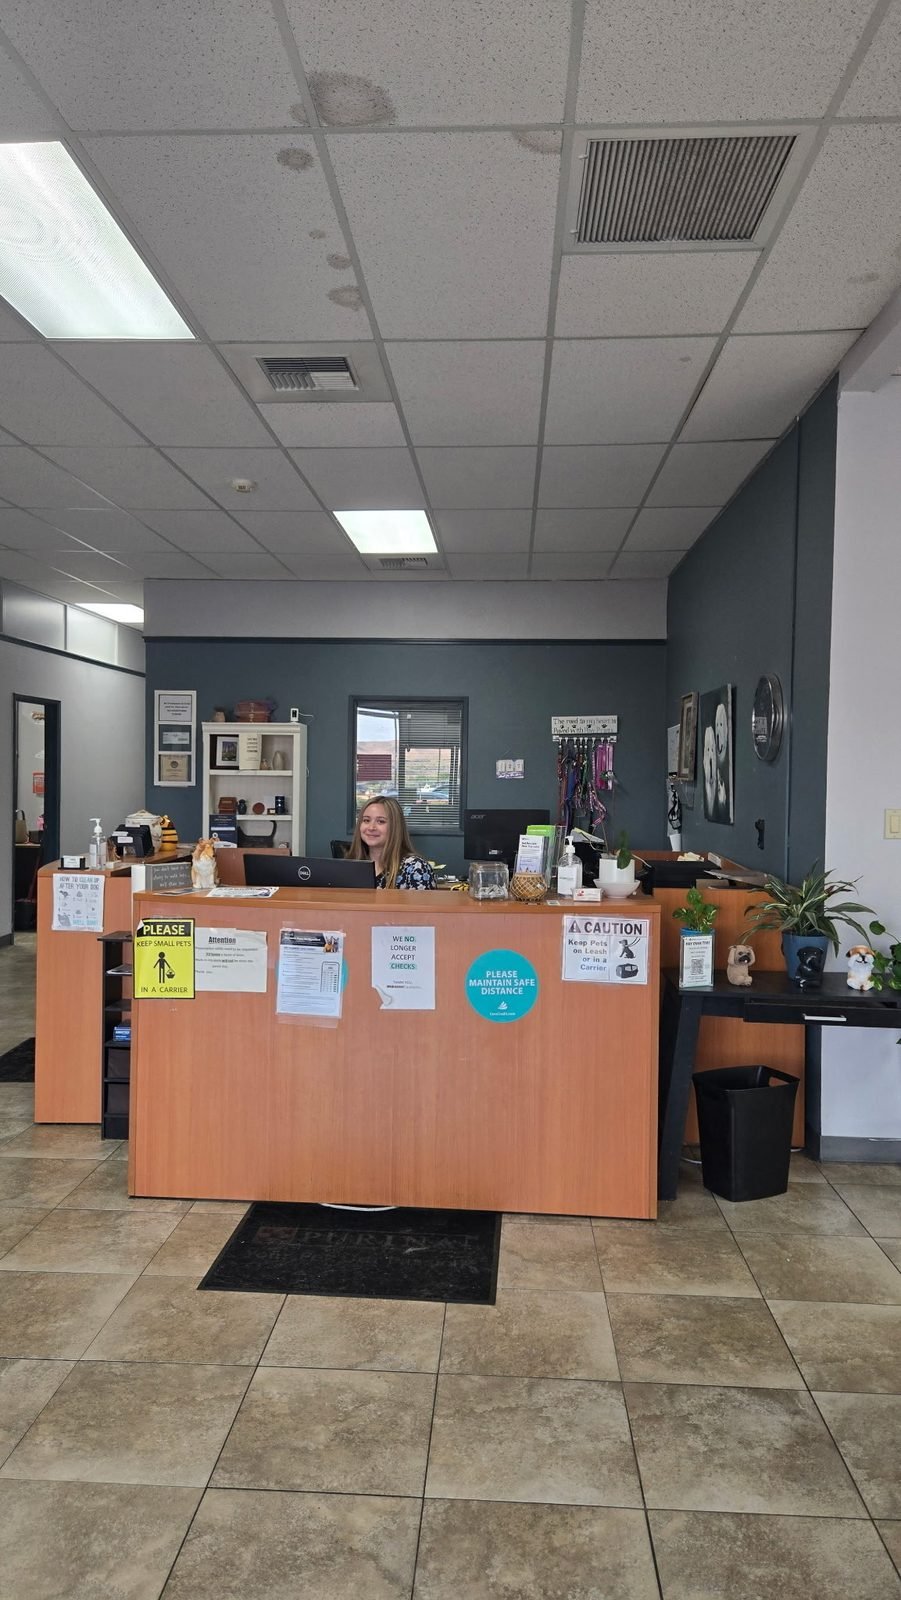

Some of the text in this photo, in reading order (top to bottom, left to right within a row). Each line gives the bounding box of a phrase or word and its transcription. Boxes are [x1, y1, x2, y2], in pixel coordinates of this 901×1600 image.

[143, 924, 185, 935] PLEASE
[584, 921, 642, 935] CAUTION
[208, 936, 237, 945] Attention
[568, 939, 588, 947] Keep
[486, 970, 518, 978] PLEASE
[469, 978, 536, 987] MAINTAIN SAFE
[481, 987, 524, 995] DISTANCE
